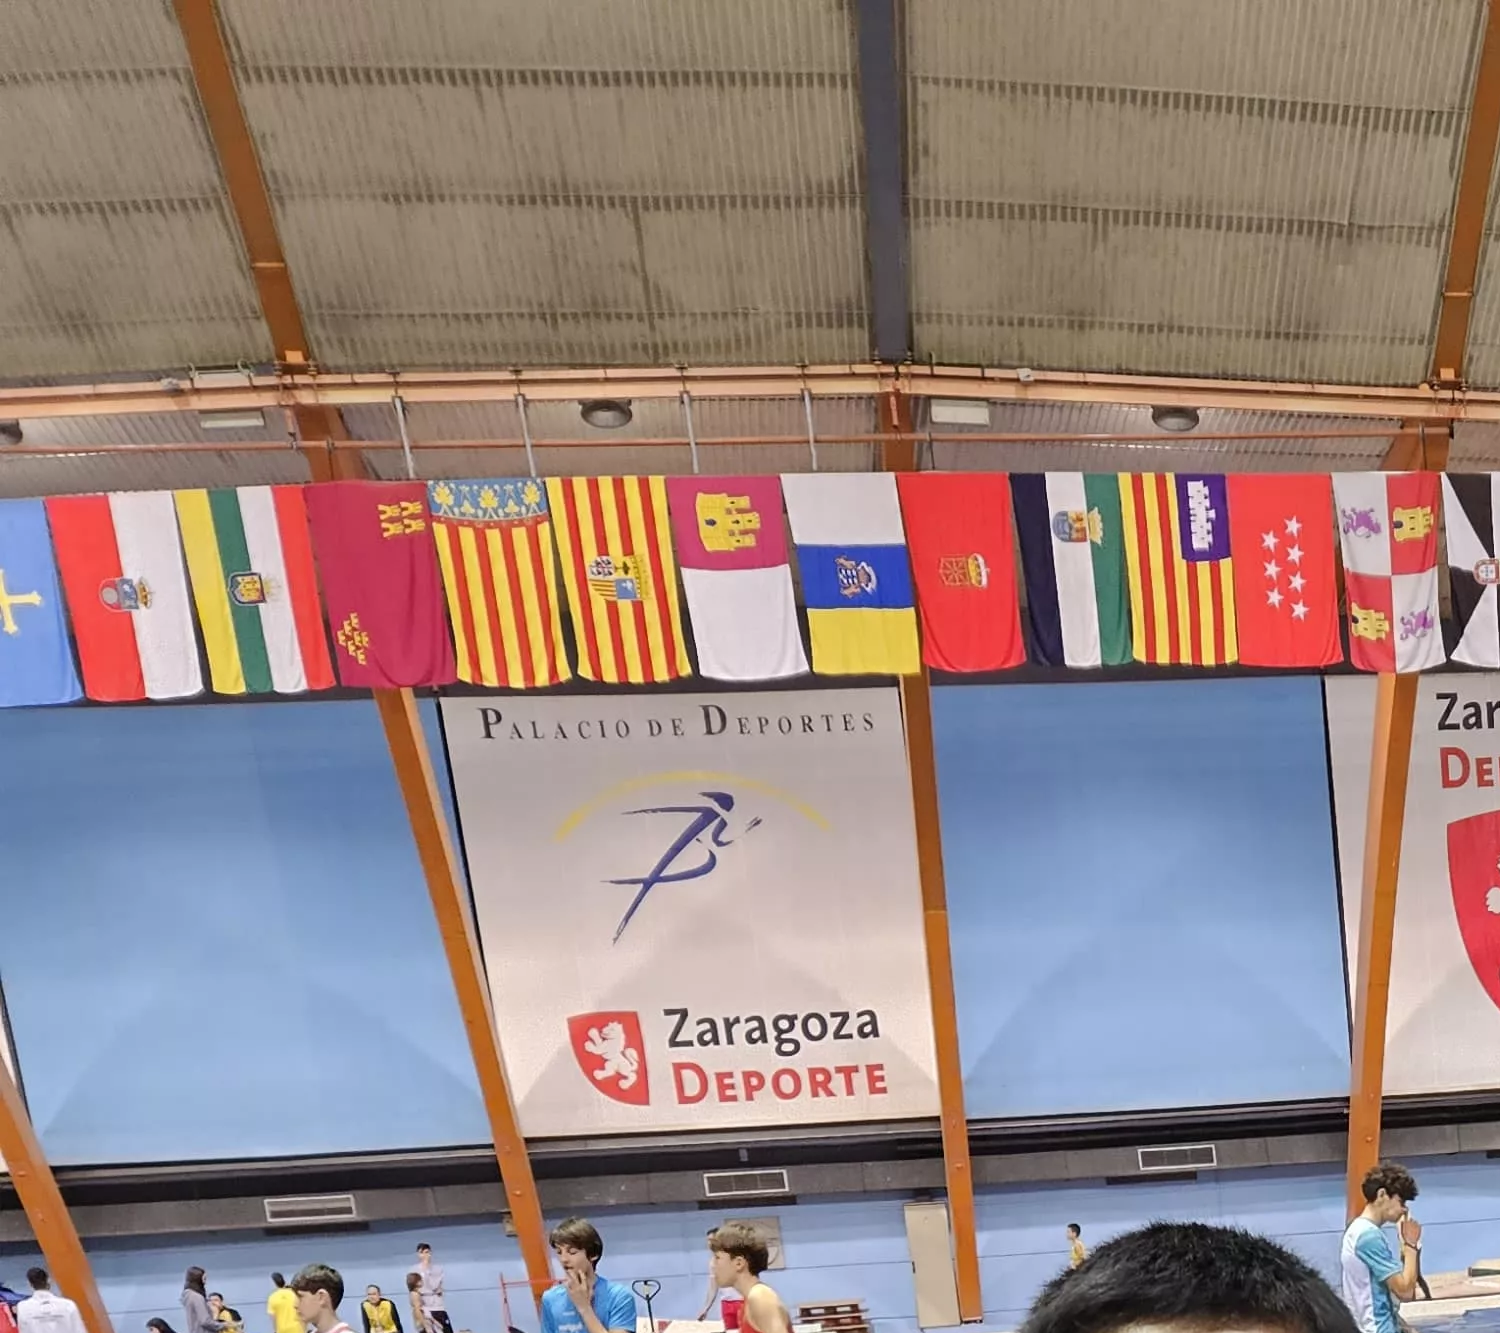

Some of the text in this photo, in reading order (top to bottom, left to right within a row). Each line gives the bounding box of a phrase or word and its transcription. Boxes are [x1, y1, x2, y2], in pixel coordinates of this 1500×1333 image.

[476, 704, 876, 741] PALACIO DE DEPORTES
[662, 1007, 881, 1057] Zaragoza
[671, 1061, 888, 1105] DEPORTE
